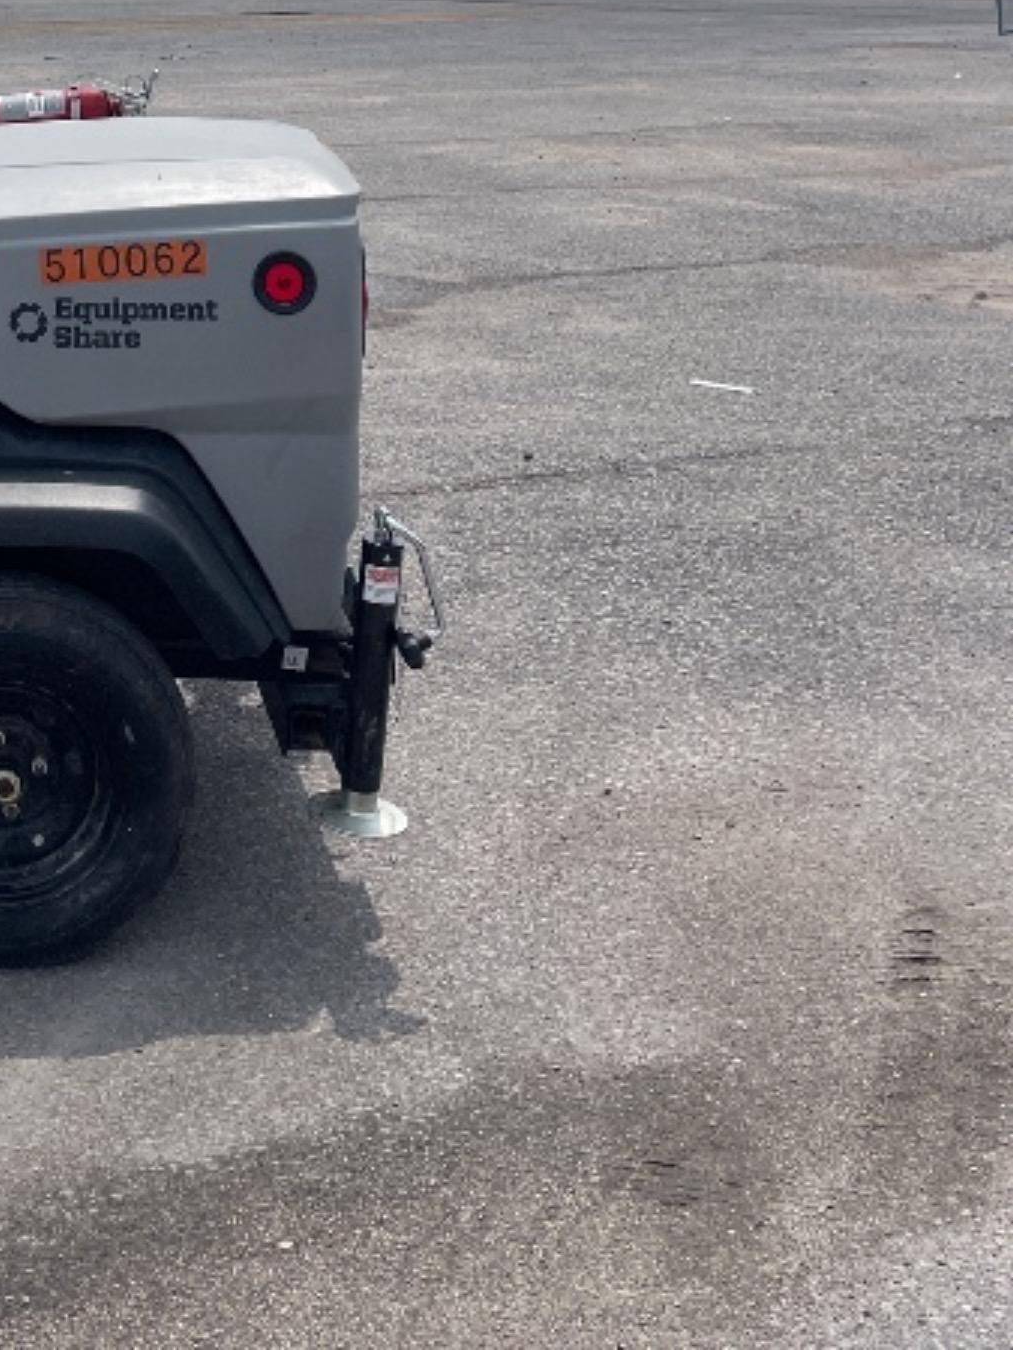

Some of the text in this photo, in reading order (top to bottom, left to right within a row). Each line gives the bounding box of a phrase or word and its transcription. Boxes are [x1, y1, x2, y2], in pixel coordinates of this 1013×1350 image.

[45, 240, 203, 283] 510062
[54, 296, 219, 325] Equipment
[53, 325, 141, 349] Share
